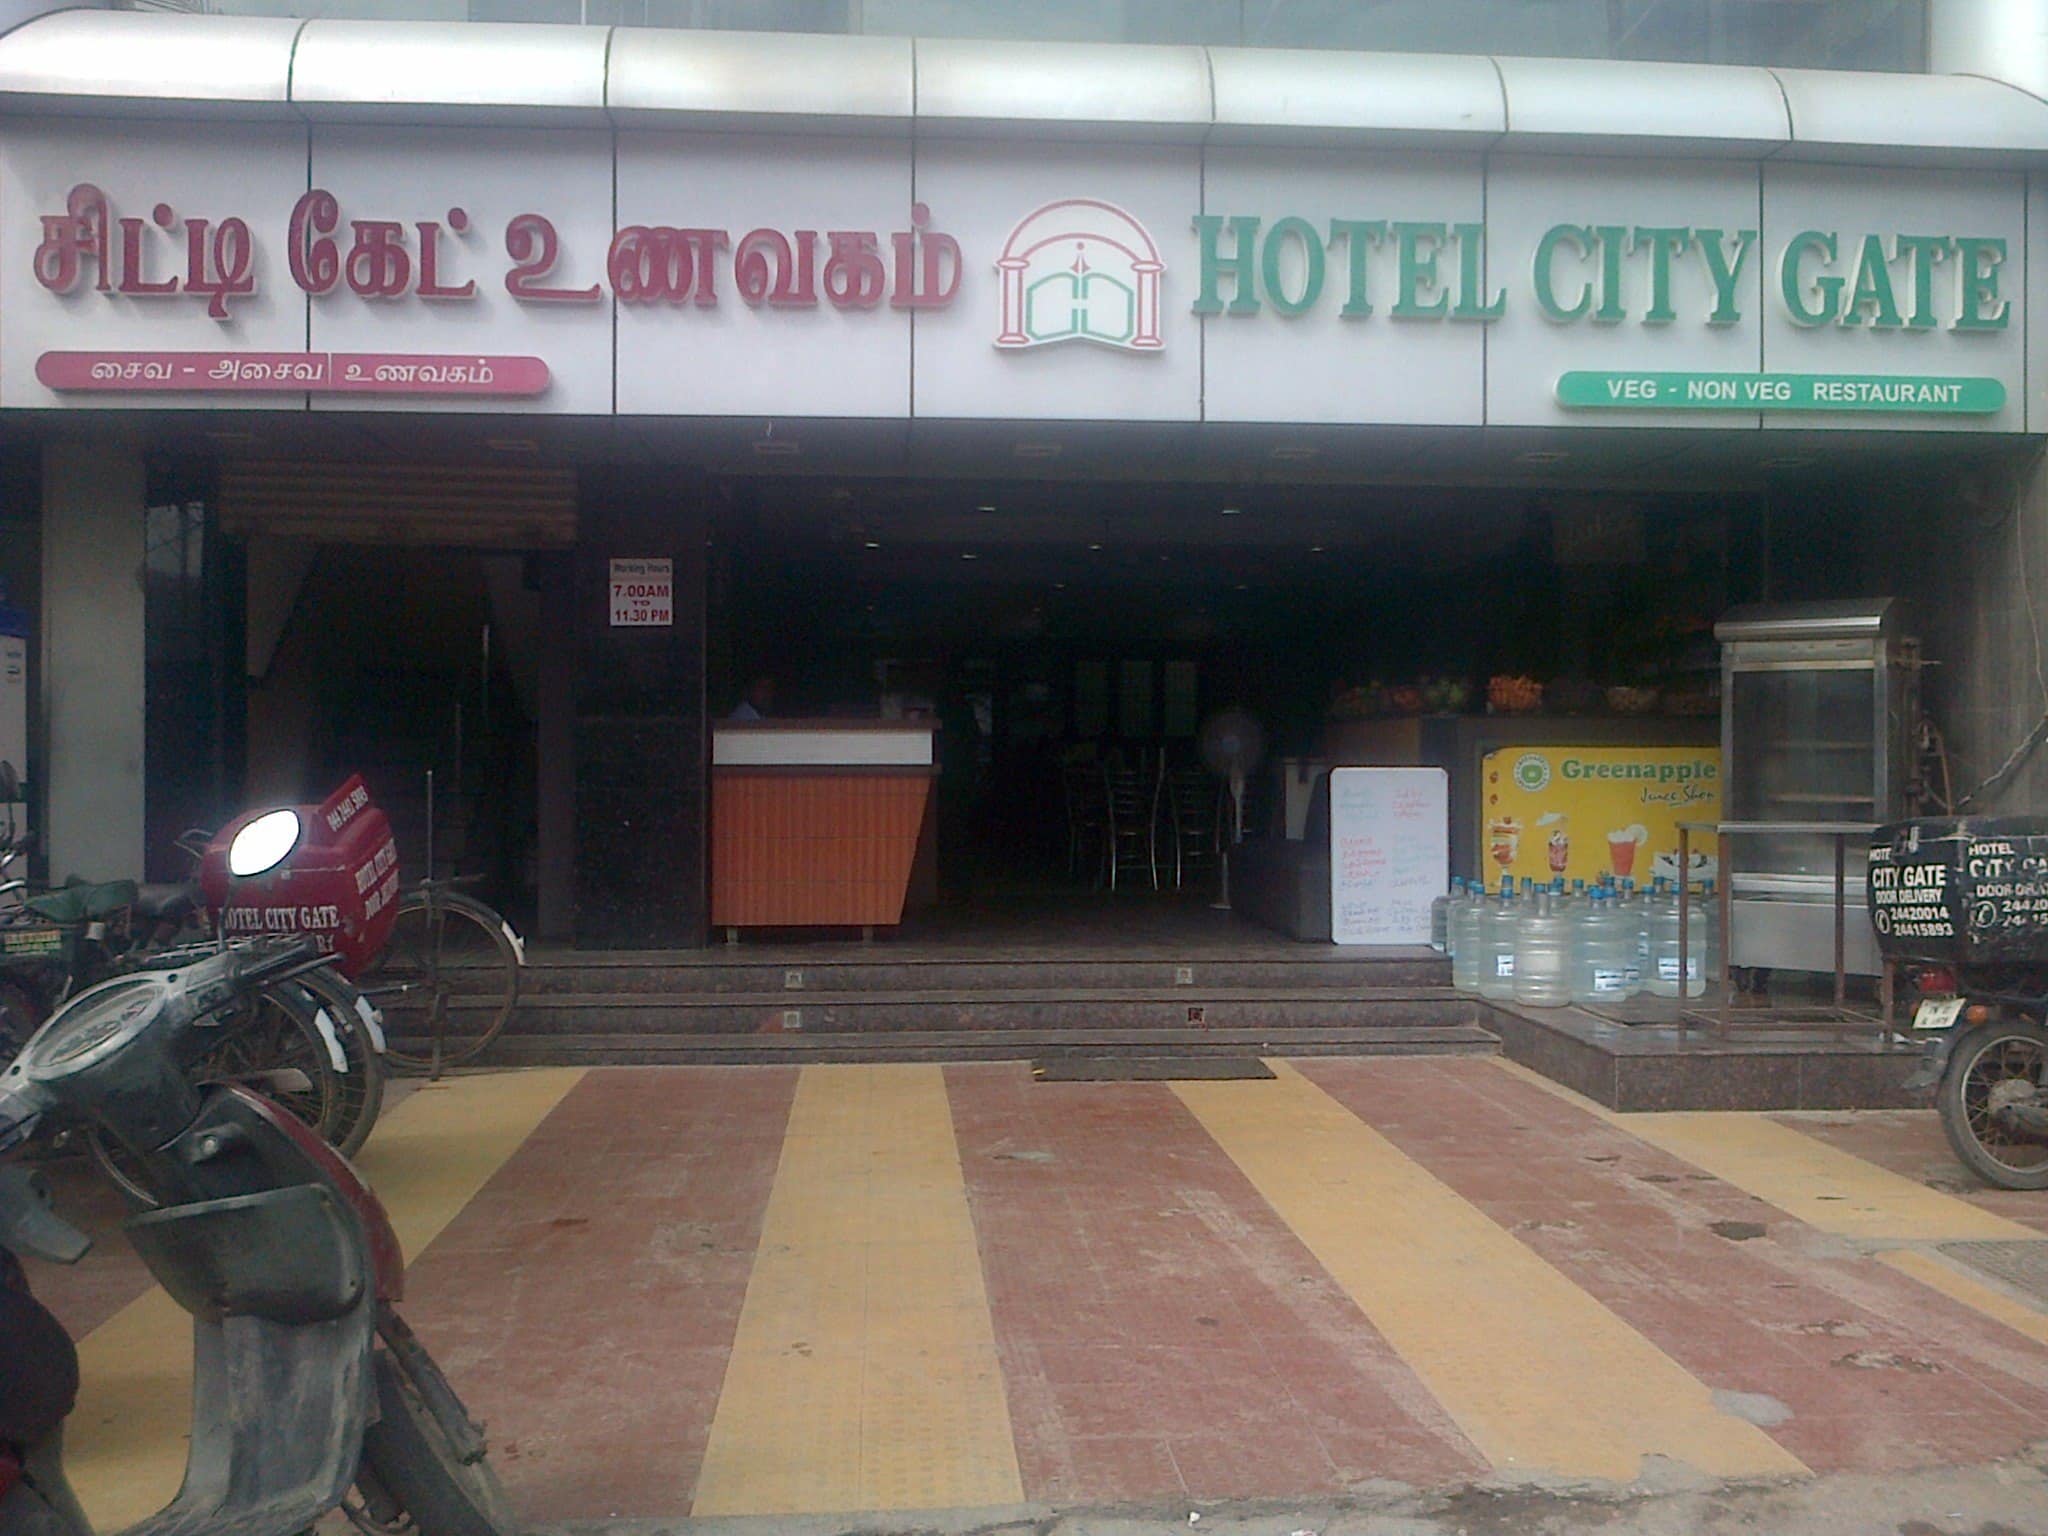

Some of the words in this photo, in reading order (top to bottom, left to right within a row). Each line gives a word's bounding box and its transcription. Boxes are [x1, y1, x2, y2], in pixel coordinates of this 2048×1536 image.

[34, 183, 255, 318] சிட்டி
[288, 189, 477, 296] கேட்
[505, 202, 963, 307] உணவகம்
[1191, 215, 1507, 320] HOTEL
[1533, 223, 1757, 327] CITY
[1778, 231, 2010, 331] GATE
[91, 361, 172, 380] சைவ
[208, 359, 323, 381] அசைவ
[345, 359, 493, 384] உணவகம்
[1607, 380, 1656, 399] VEG
[1688, 381, 1737, 400] NON
[1745, 382, 1791, 400] VEG
[1813, 383, 1962, 403] RESTAURANT
[651, 609, 669, 621] PM
[1560, 759, 1717, 782] Greenapple
[1968, 842, 2015, 856] HOTEL
[1872, 866, 1900, 888] CITY
[1904, 865, 1946, 886] GATE
[1899, 888, 1942, 903] DELIVERY
[265, 907, 297, 929] CITY
[301, 905, 340, 928] GATE
